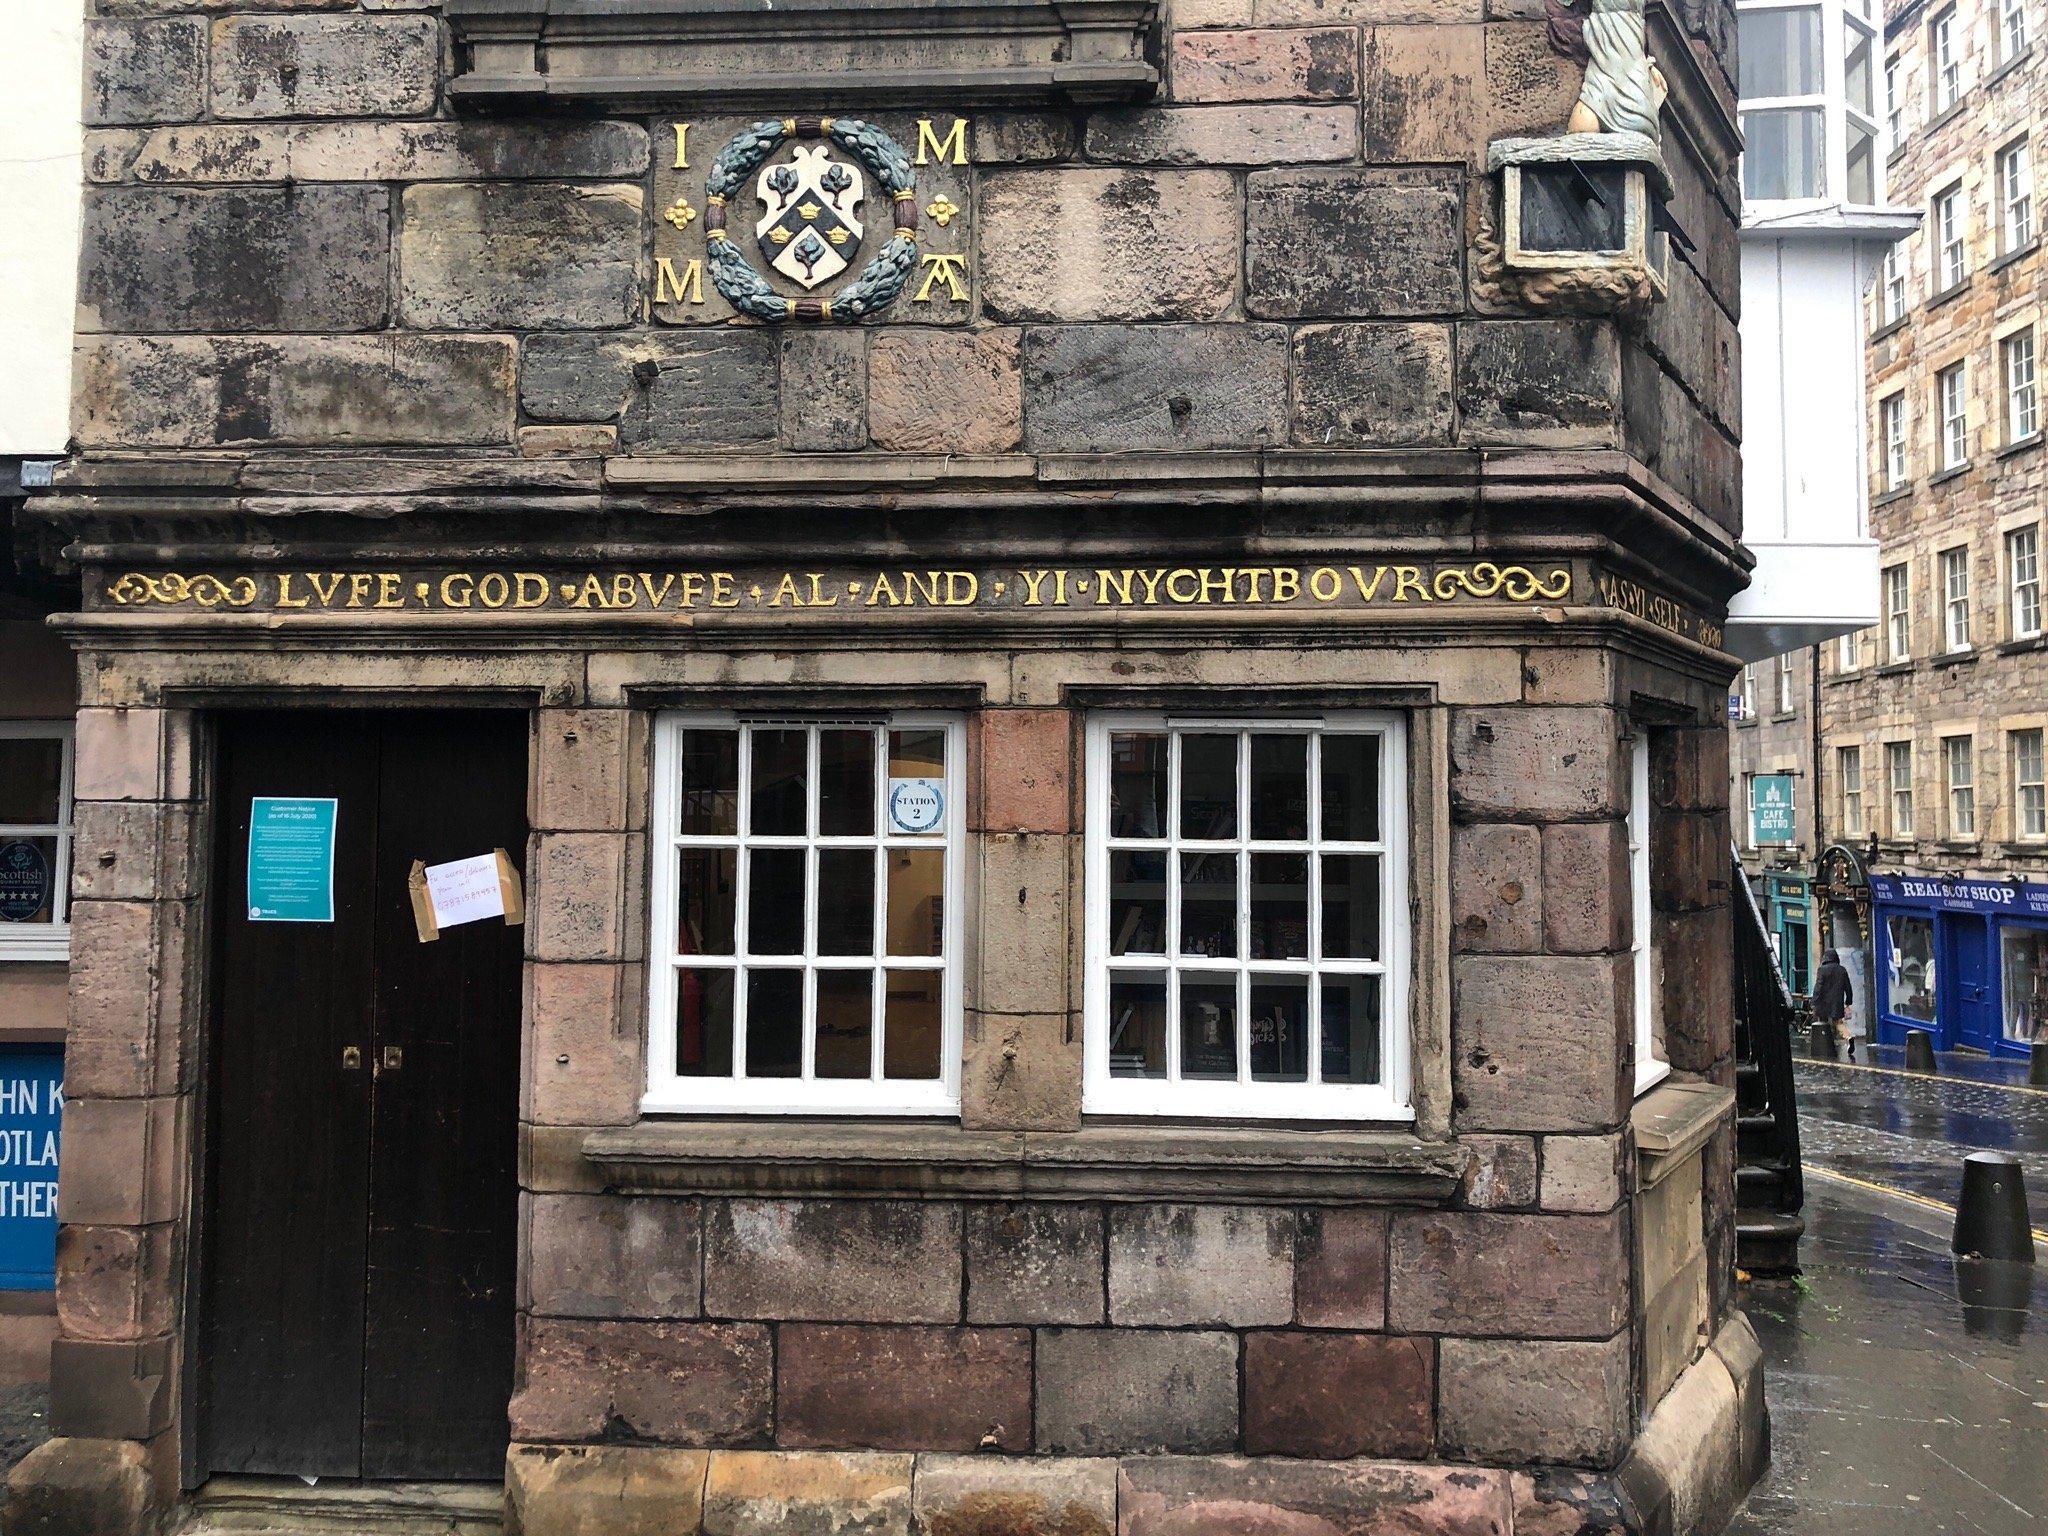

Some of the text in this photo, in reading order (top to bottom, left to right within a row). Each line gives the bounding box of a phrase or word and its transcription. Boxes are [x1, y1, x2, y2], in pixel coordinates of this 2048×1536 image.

[672, 123, 690, 169] I
[914, 118, 969, 166] M
[654, 257, 705, 305] M
[275, 573, 405, 609] LVFE
[440, 572, 551, 608] GOD
[768, 572, 839, 608] AL
[865, 570, 979, 607] AND
[1018, 569, 1072, 606] YI
[896, 797, 936, 806] STATION
[912, 808, 921, 820] 2
[1760, 819, 1788, 829] BISTRO
[1763, 809, 1784, 820] CAFE
[1901, 881, 2015, 905] REAL SCOT SHOP
